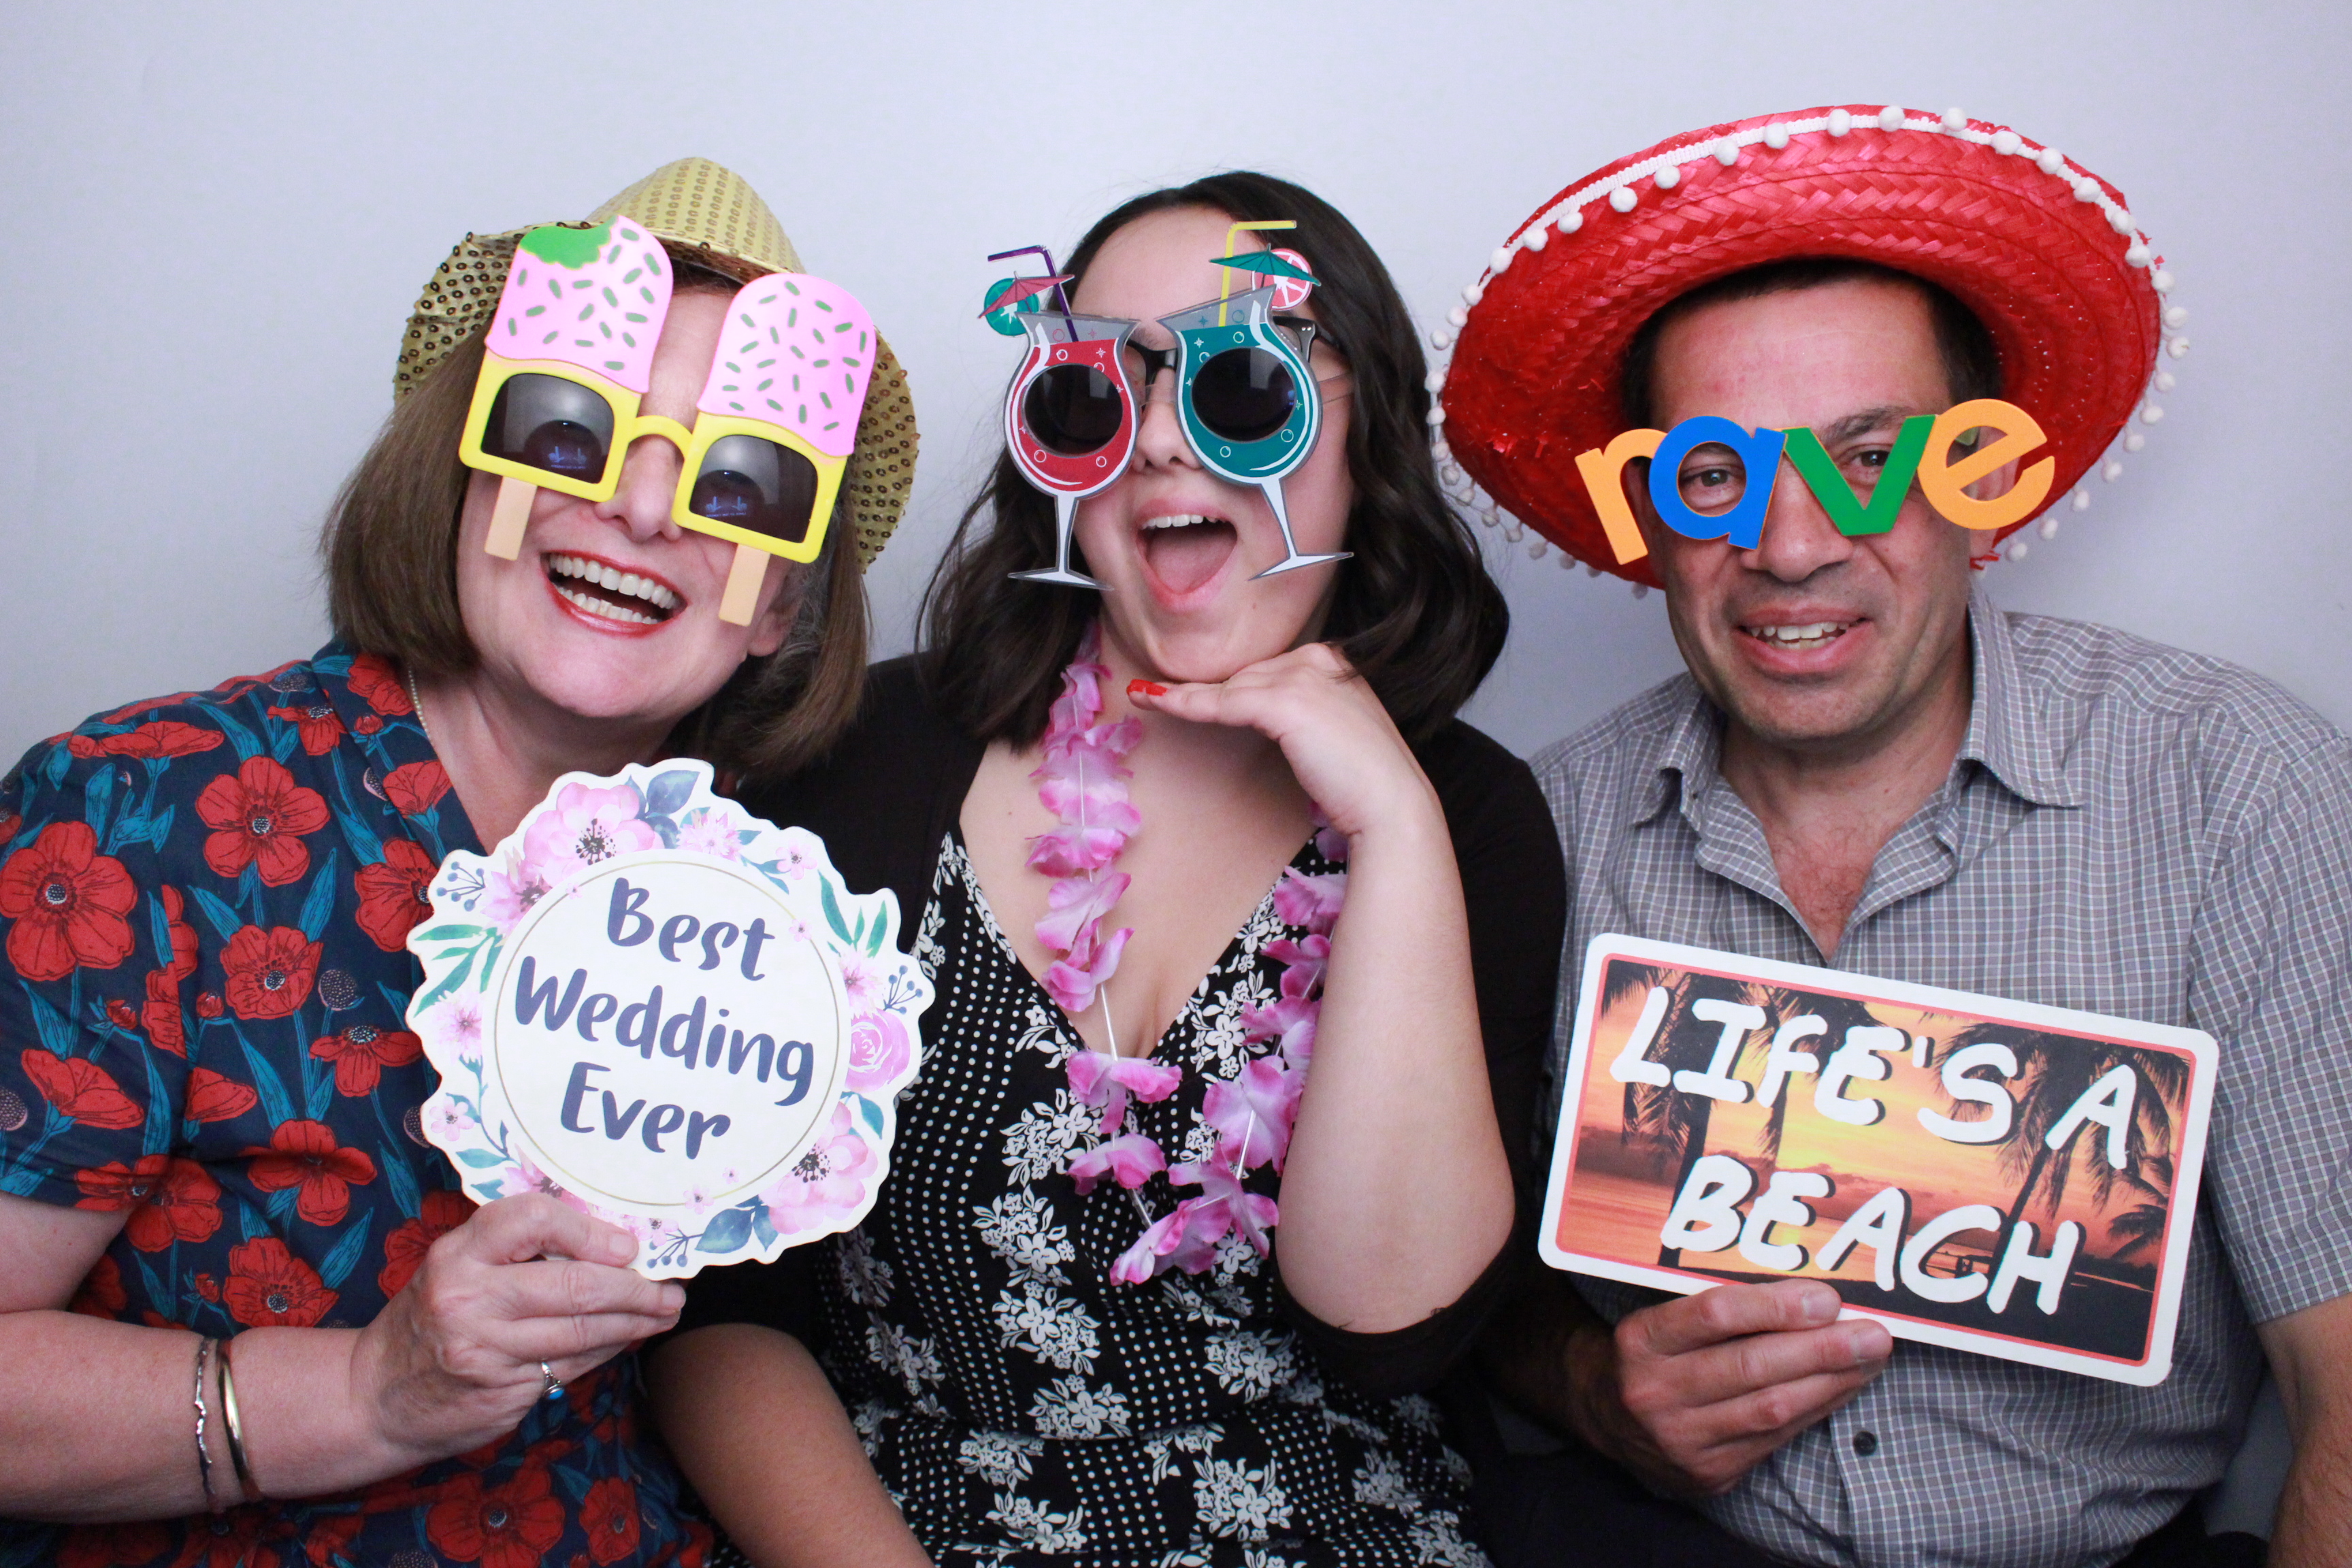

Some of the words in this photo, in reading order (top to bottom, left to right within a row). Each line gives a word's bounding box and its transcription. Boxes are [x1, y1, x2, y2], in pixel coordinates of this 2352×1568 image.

[1574, 398, 2055, 565] rave
[606, 877, 775, 982] Best
[514, 956, 815, 1107] Wedding
[1610, 985, 2019, 1144] LIFE'S
[2045, 1064, 2138, 1170] A
[560, 1061, 732, 1160] Ever
[1661, 1154, 2081, 1316] BEACH
